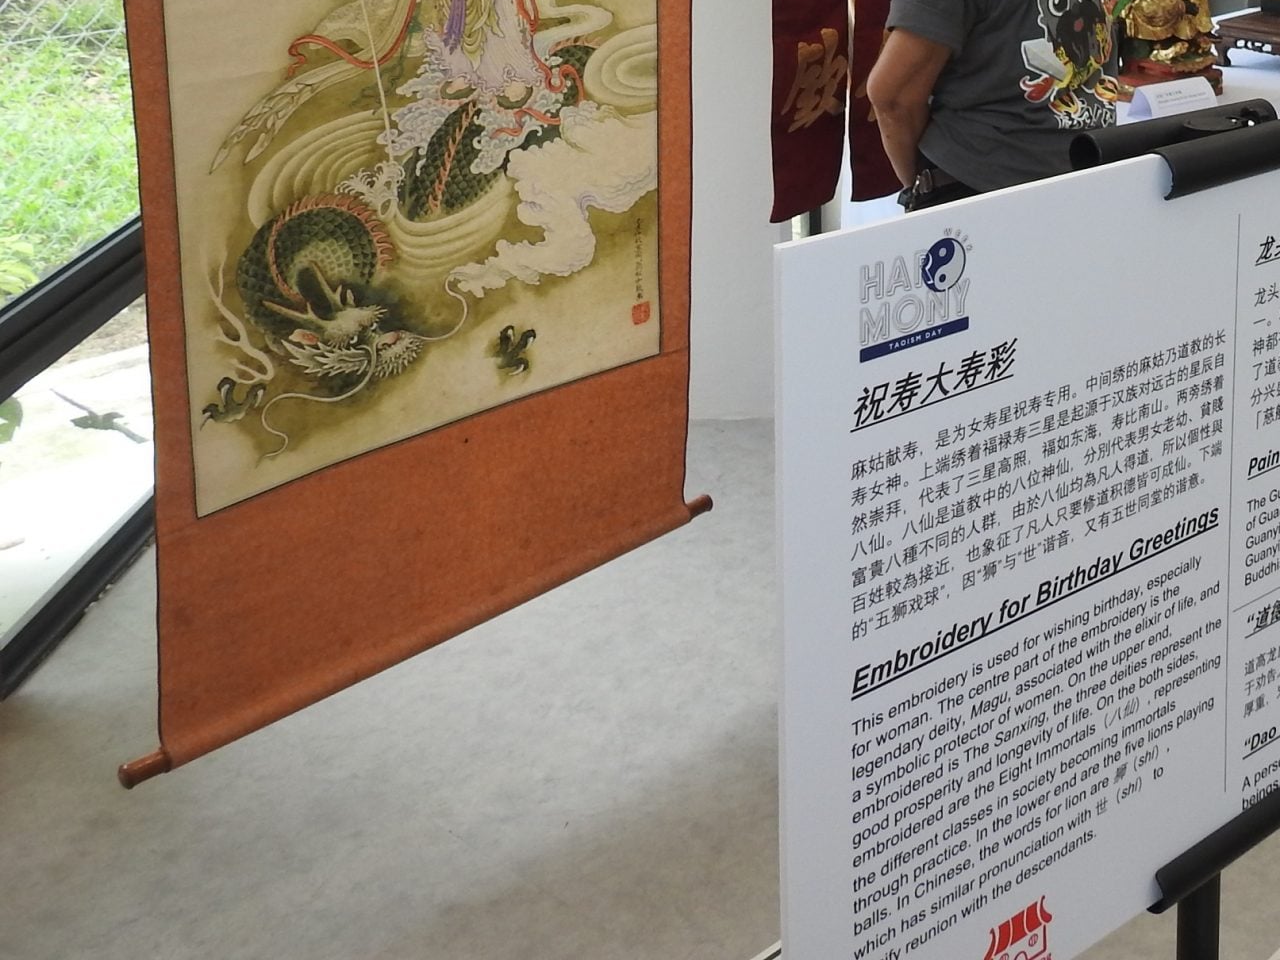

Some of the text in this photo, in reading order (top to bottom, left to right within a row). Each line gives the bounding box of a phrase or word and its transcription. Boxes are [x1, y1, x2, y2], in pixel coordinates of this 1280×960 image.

[853, 337, 1018, 427] 祝寿大寿彩
[889, 328, 943, 351] TAOISM DAY
[1246, 496, 1267, 513] The
[851, 507, 1219, 695] Embroidery for Birthday Greetings
[851, 556, 1202, 736] This embroidery is used for wishing birthday, especially
[851, 585, 1180, 760] for woman. The centre part of the embroidery is the
[852, 580, 1220, 782] legendary deity, Magu, associated with the elixir of life, and
[852, 624, 1172, 803] a symbolic protector of women. On the upper end,
[852, 618, 1222, 824] embroidered is The Sanxing, the three deities represent the
[852, 650, 1198, 850] good prosperity and longevity of life. On the both sides,
[852, 655, 1221, 868] embroidered are the Eight Immortals representing
[853, 700, 1176, 893] the different classes in society becoming immortals
[1241, 775, 1251, 792] A
[853, 697, 1214, 915] through practice. In the lower end are the five lions playing
